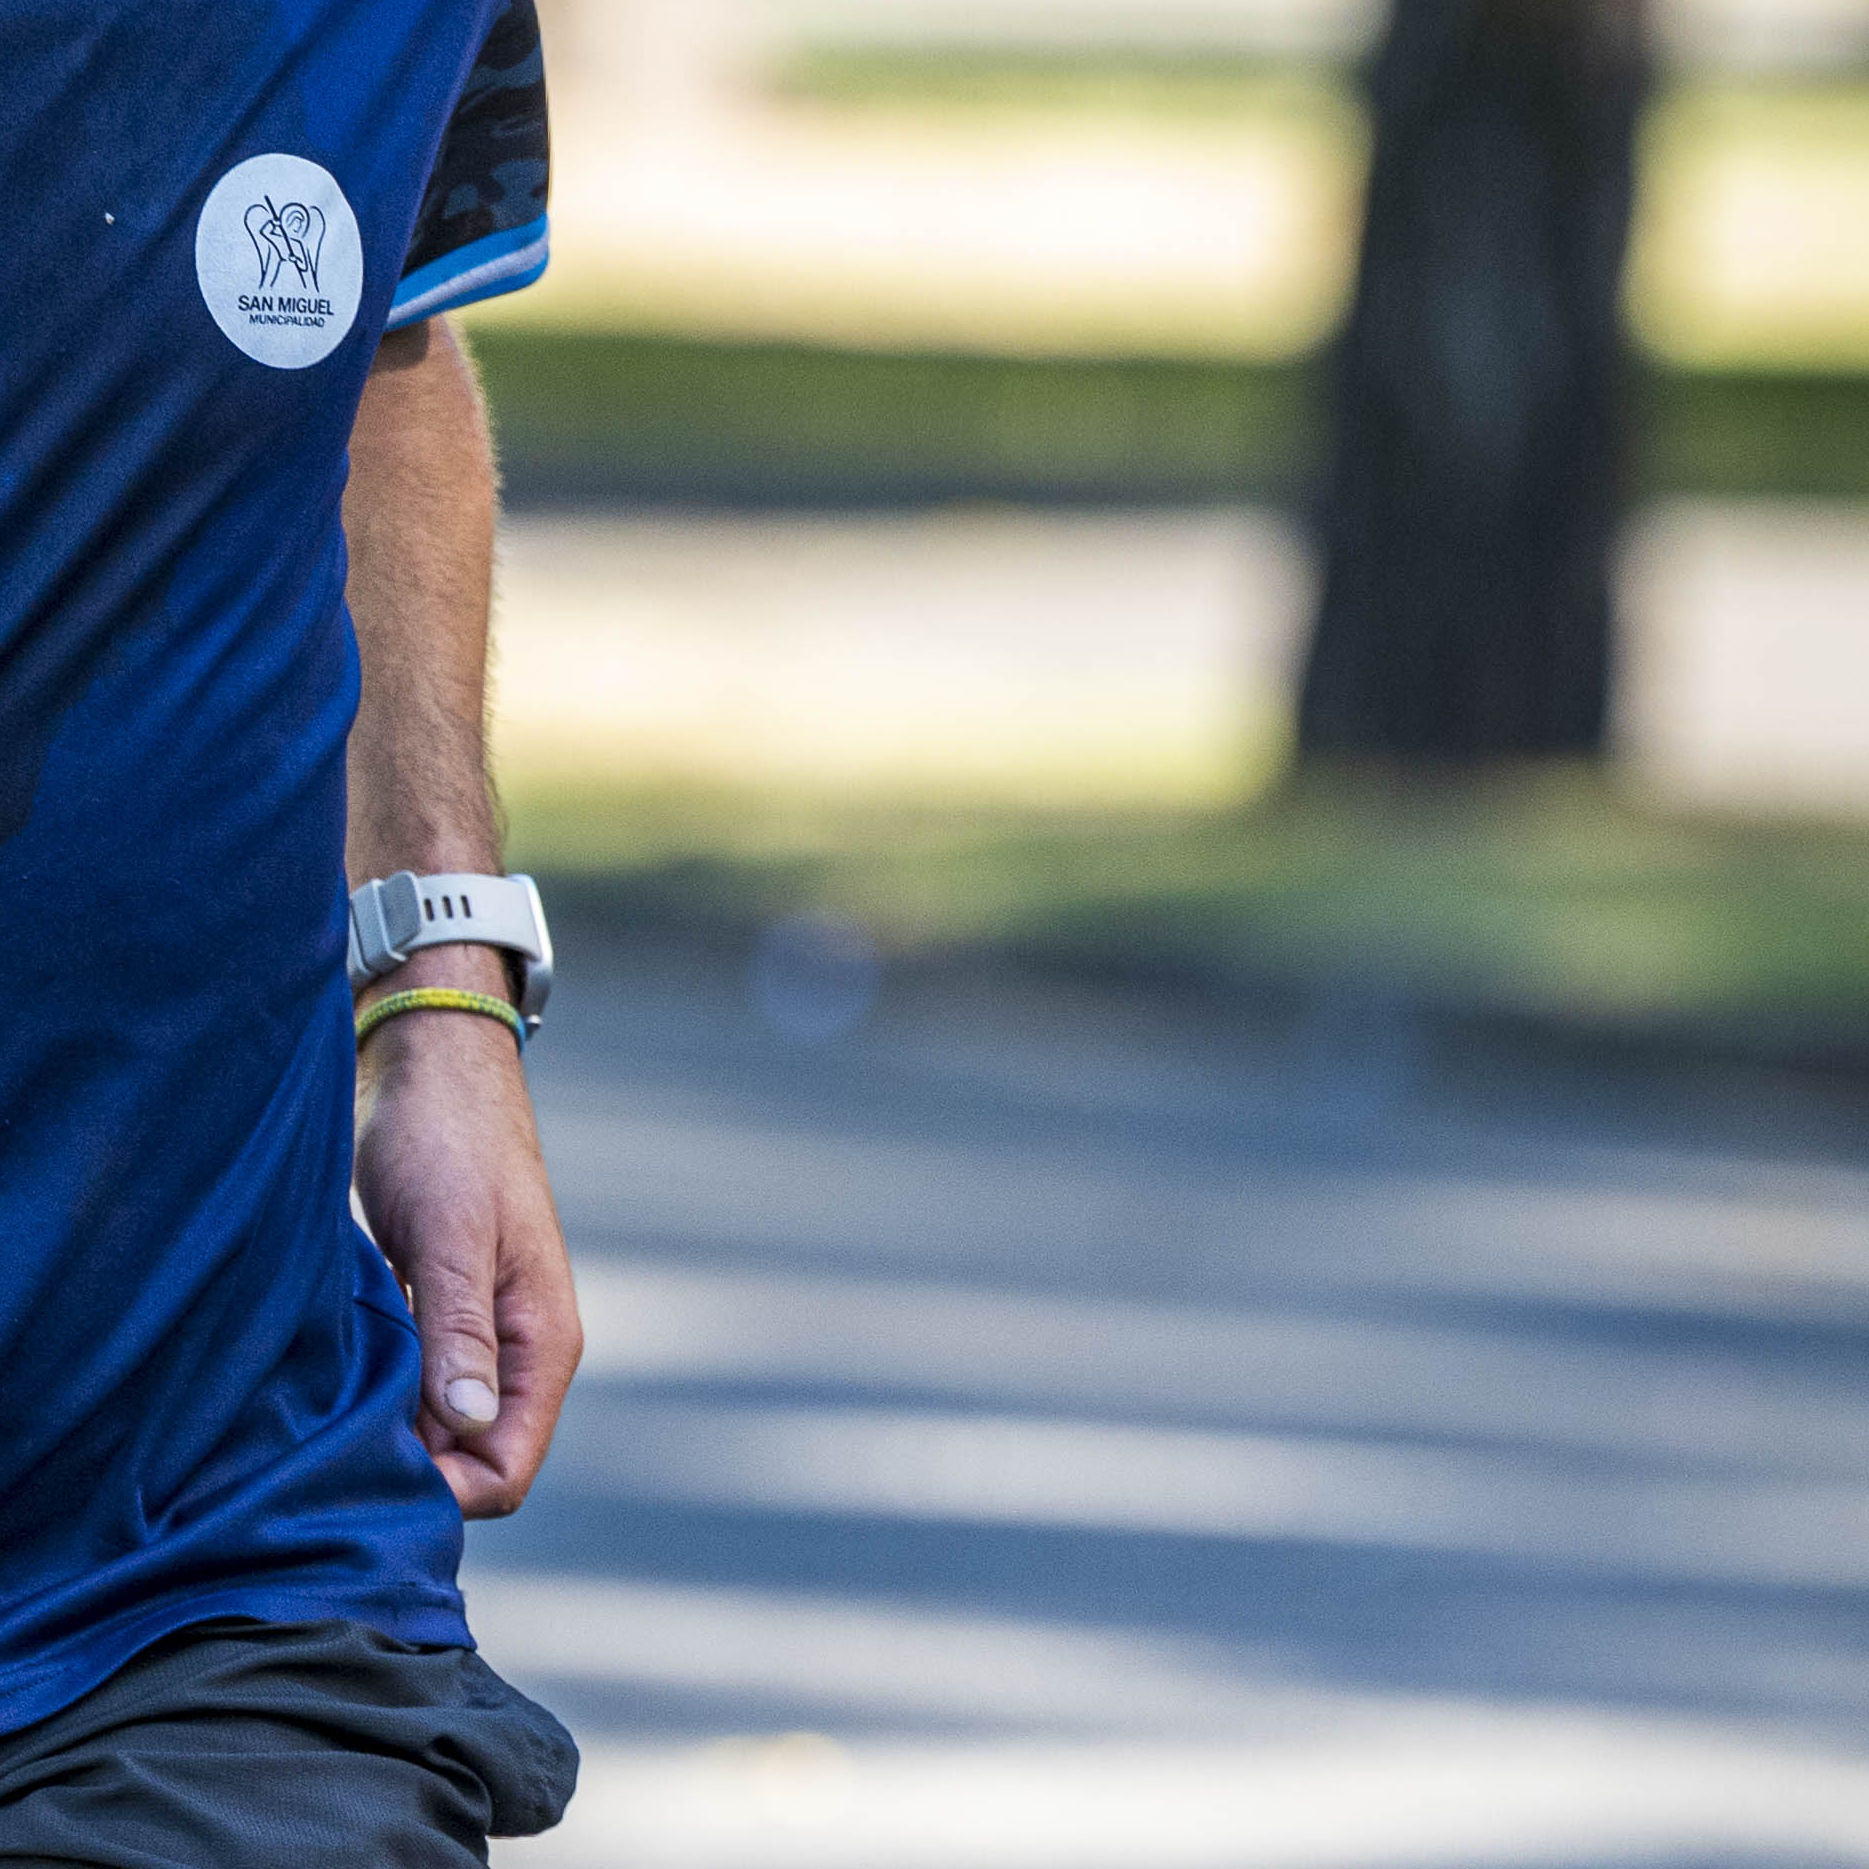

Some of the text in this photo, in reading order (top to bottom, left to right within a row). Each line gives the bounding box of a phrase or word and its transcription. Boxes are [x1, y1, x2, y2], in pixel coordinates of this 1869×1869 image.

[238, 294, 334, 315] SAN MIGUEL
[249, 314, 325, 327] MUNICIPALIDAD
